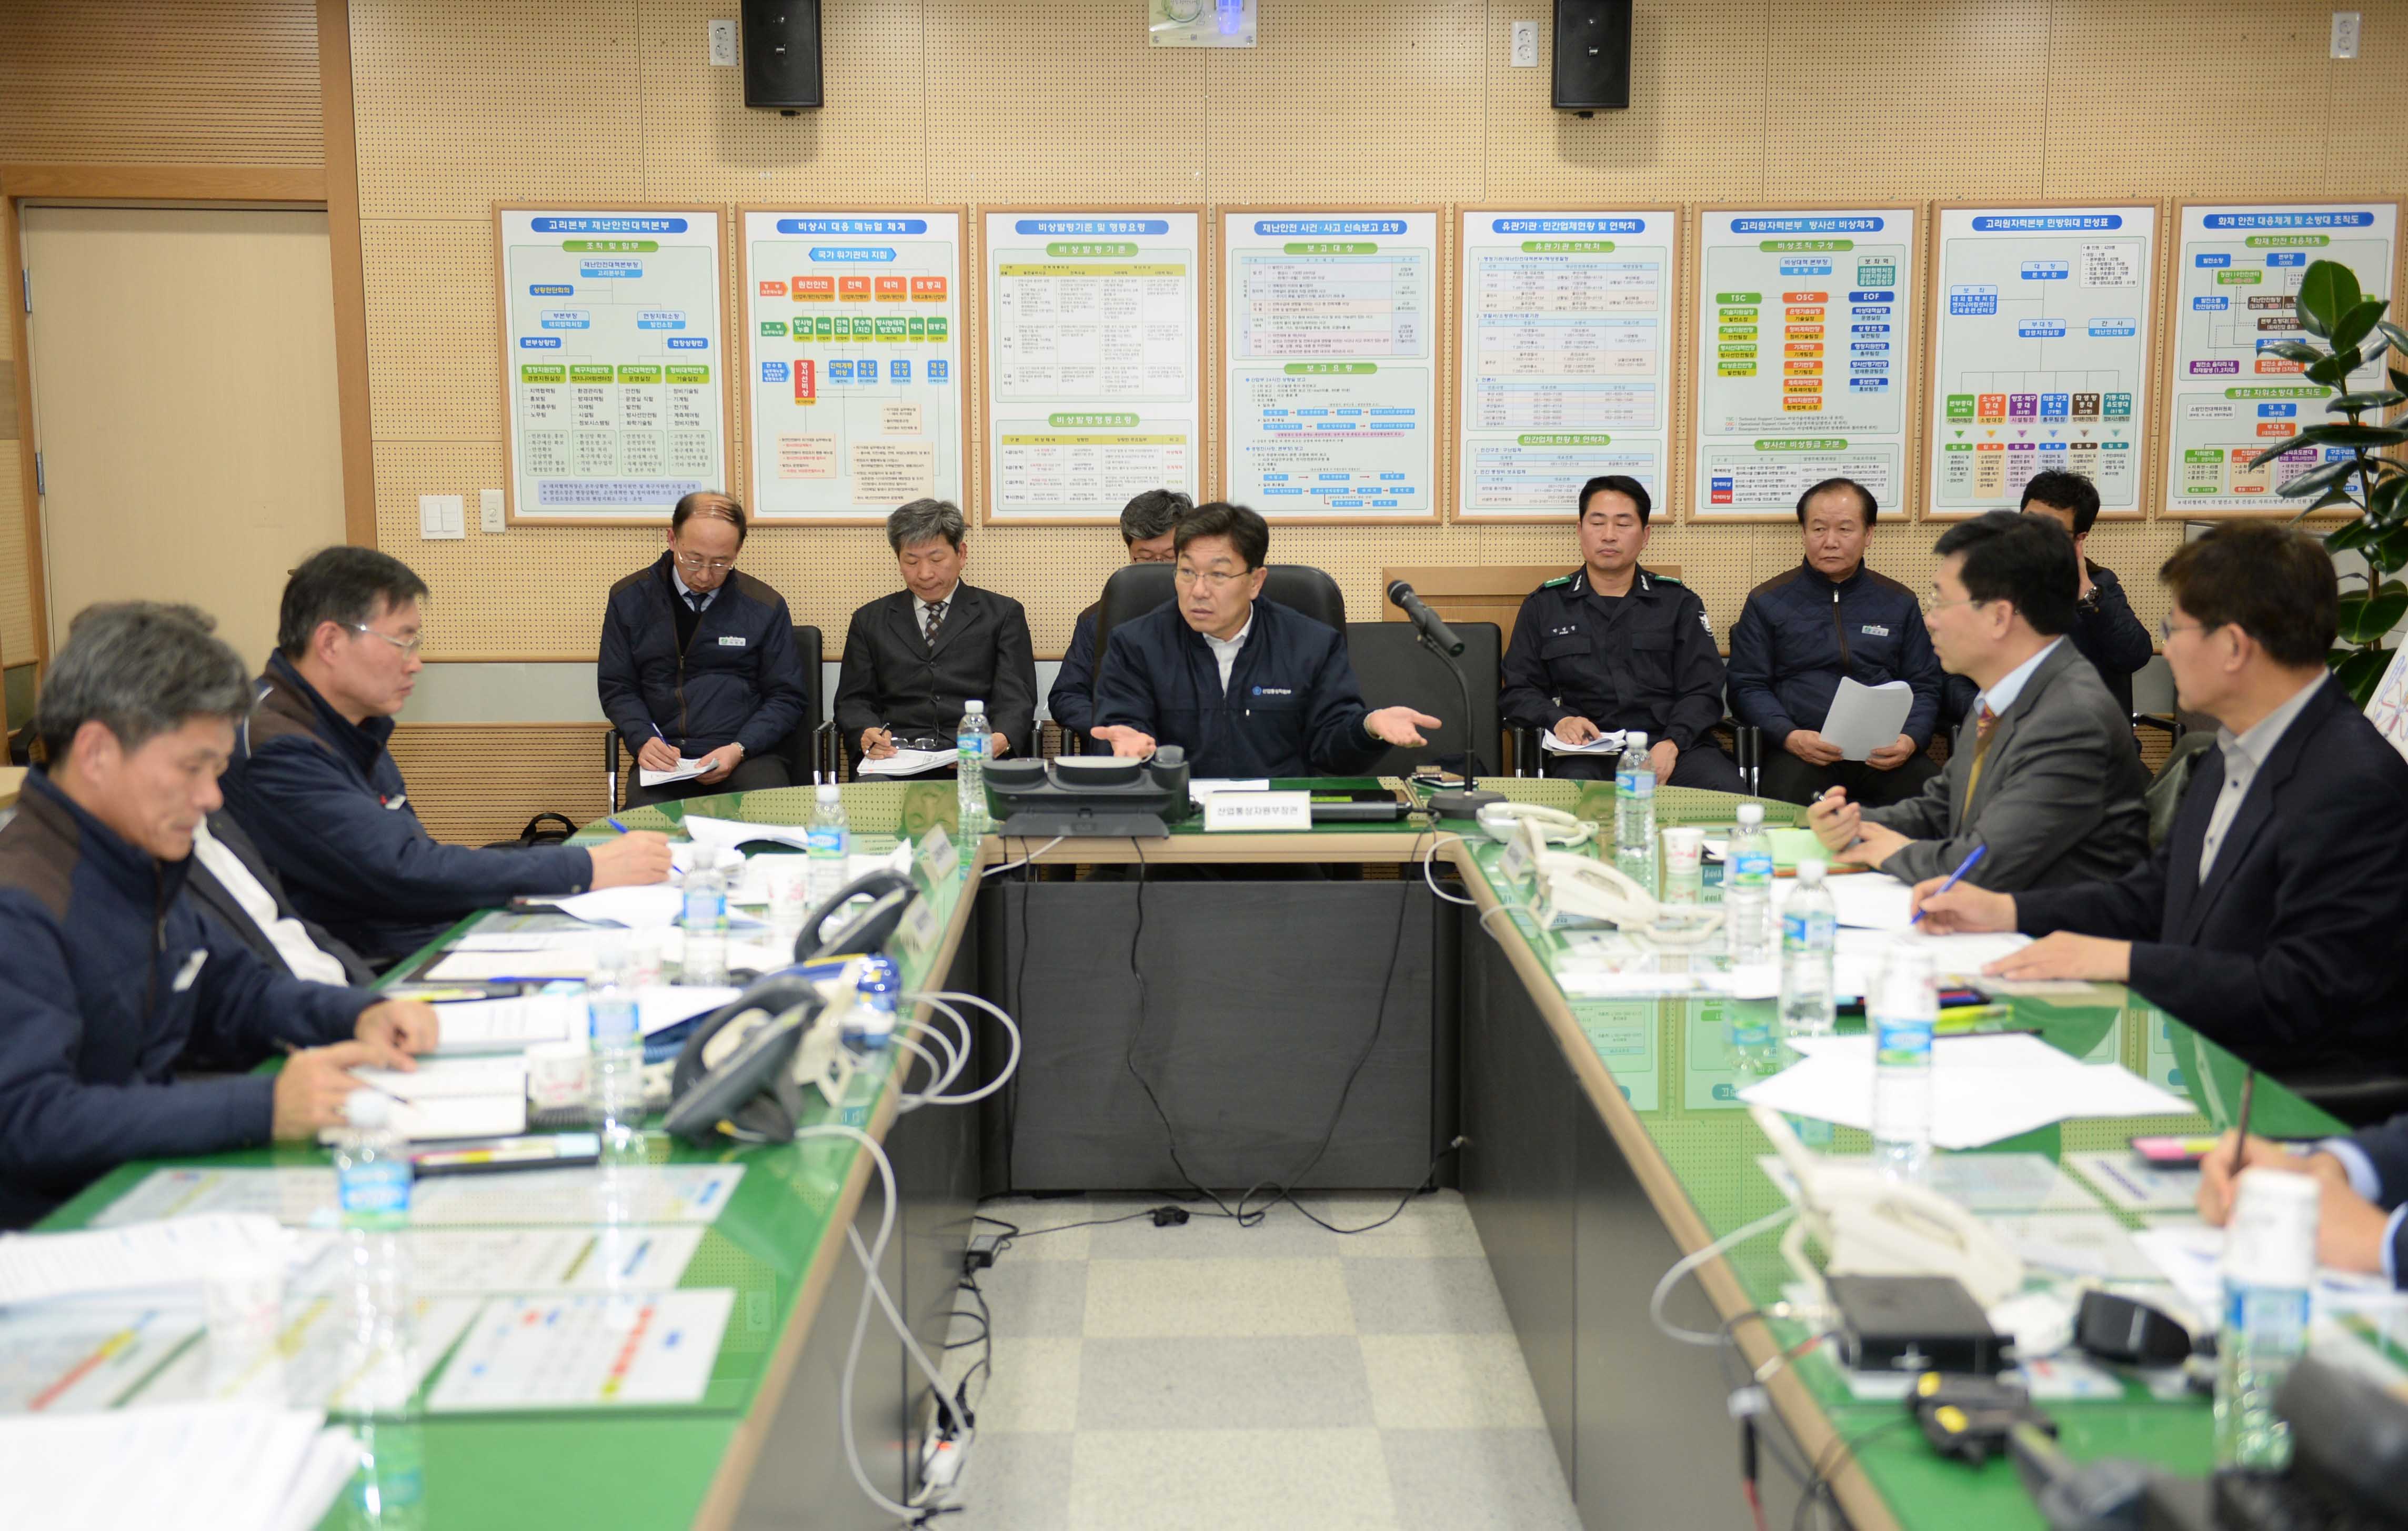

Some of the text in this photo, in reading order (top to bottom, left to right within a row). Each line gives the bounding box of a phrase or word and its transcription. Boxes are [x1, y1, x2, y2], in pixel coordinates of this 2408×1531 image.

[549, 221, 670, 230] 고리본부 재난안전대책본부
[1740, 220, 1874, 230] 고리원자력본부 방사선 비상체계
[1985, 219, 2044, 228] 고리원자력본부
[2047, 219, 2080, 227] 민방위대
[2218, 217, 2235, 226] 화재
[2258, 216, 2291, 225] 대응체계
[2295, 216, 2302, 225] 및
[2305, 216, 2330, 225] 소방대
[798, 222, 906, 231] 비상시 대응 매뉴얼 체계
[1038, 223, 1146, 231] 비상발령기준 및 행동요령
[1262, 224, 1297, 232] 재난안전
[1301, 224, 1341, 232] 사건·사고
[1345, 224, 1378, 232] 신속보고
[1502, 221, 1636, 231] 유관기관·민간업체현황 및 연락처
